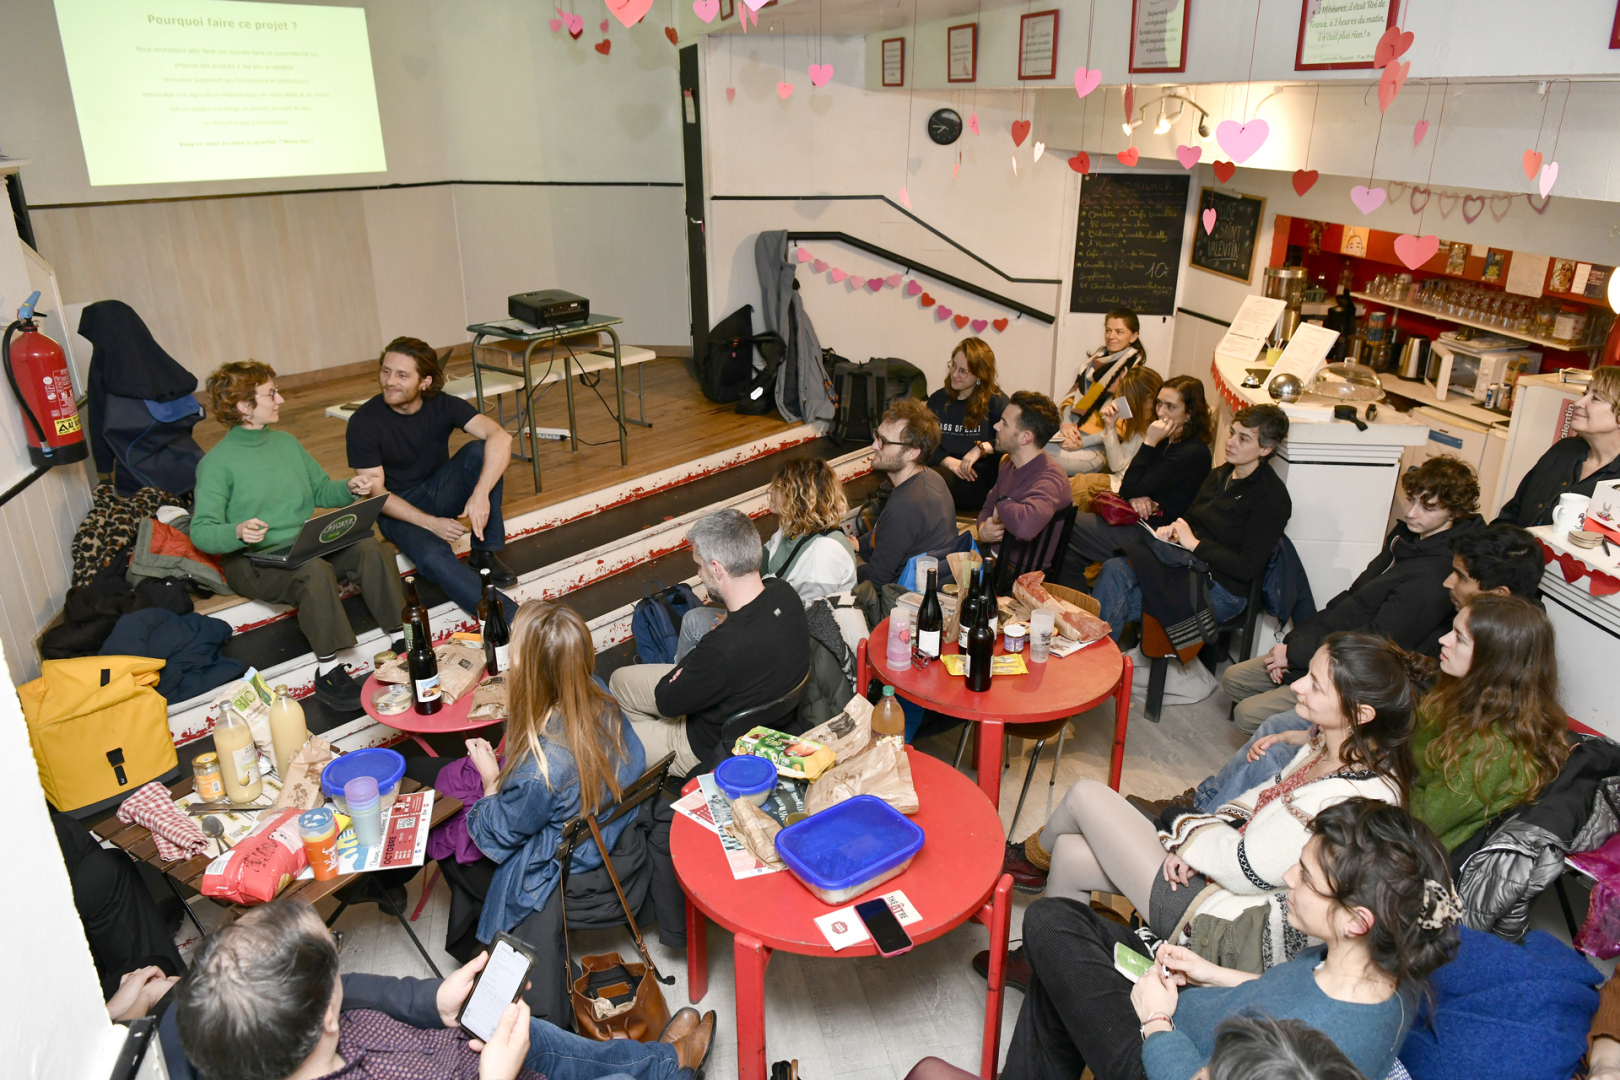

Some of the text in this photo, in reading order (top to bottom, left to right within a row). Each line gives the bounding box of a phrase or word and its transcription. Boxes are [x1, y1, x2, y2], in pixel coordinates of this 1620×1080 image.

[147, 14, 203, 27] Pourquoi
[207, 18, 234, 28] faire
[255, 20, 288, 32] projet
[292, 22, 297, 30] ?
[1338, 17, 1356, 26] heures
[1338, 30, 1350, 43] plus
[1351, 31, 1363, 39] rien
[1093, 176, 1111, 194] Le
[940, 423, 953, 432] ASS
[954, 424, 963, 433] OF
[1558, 403, 1574, 440] alentin
[232, 690, 256, 712] BIO
[383, 836, 397, 865] OCTOBRE
